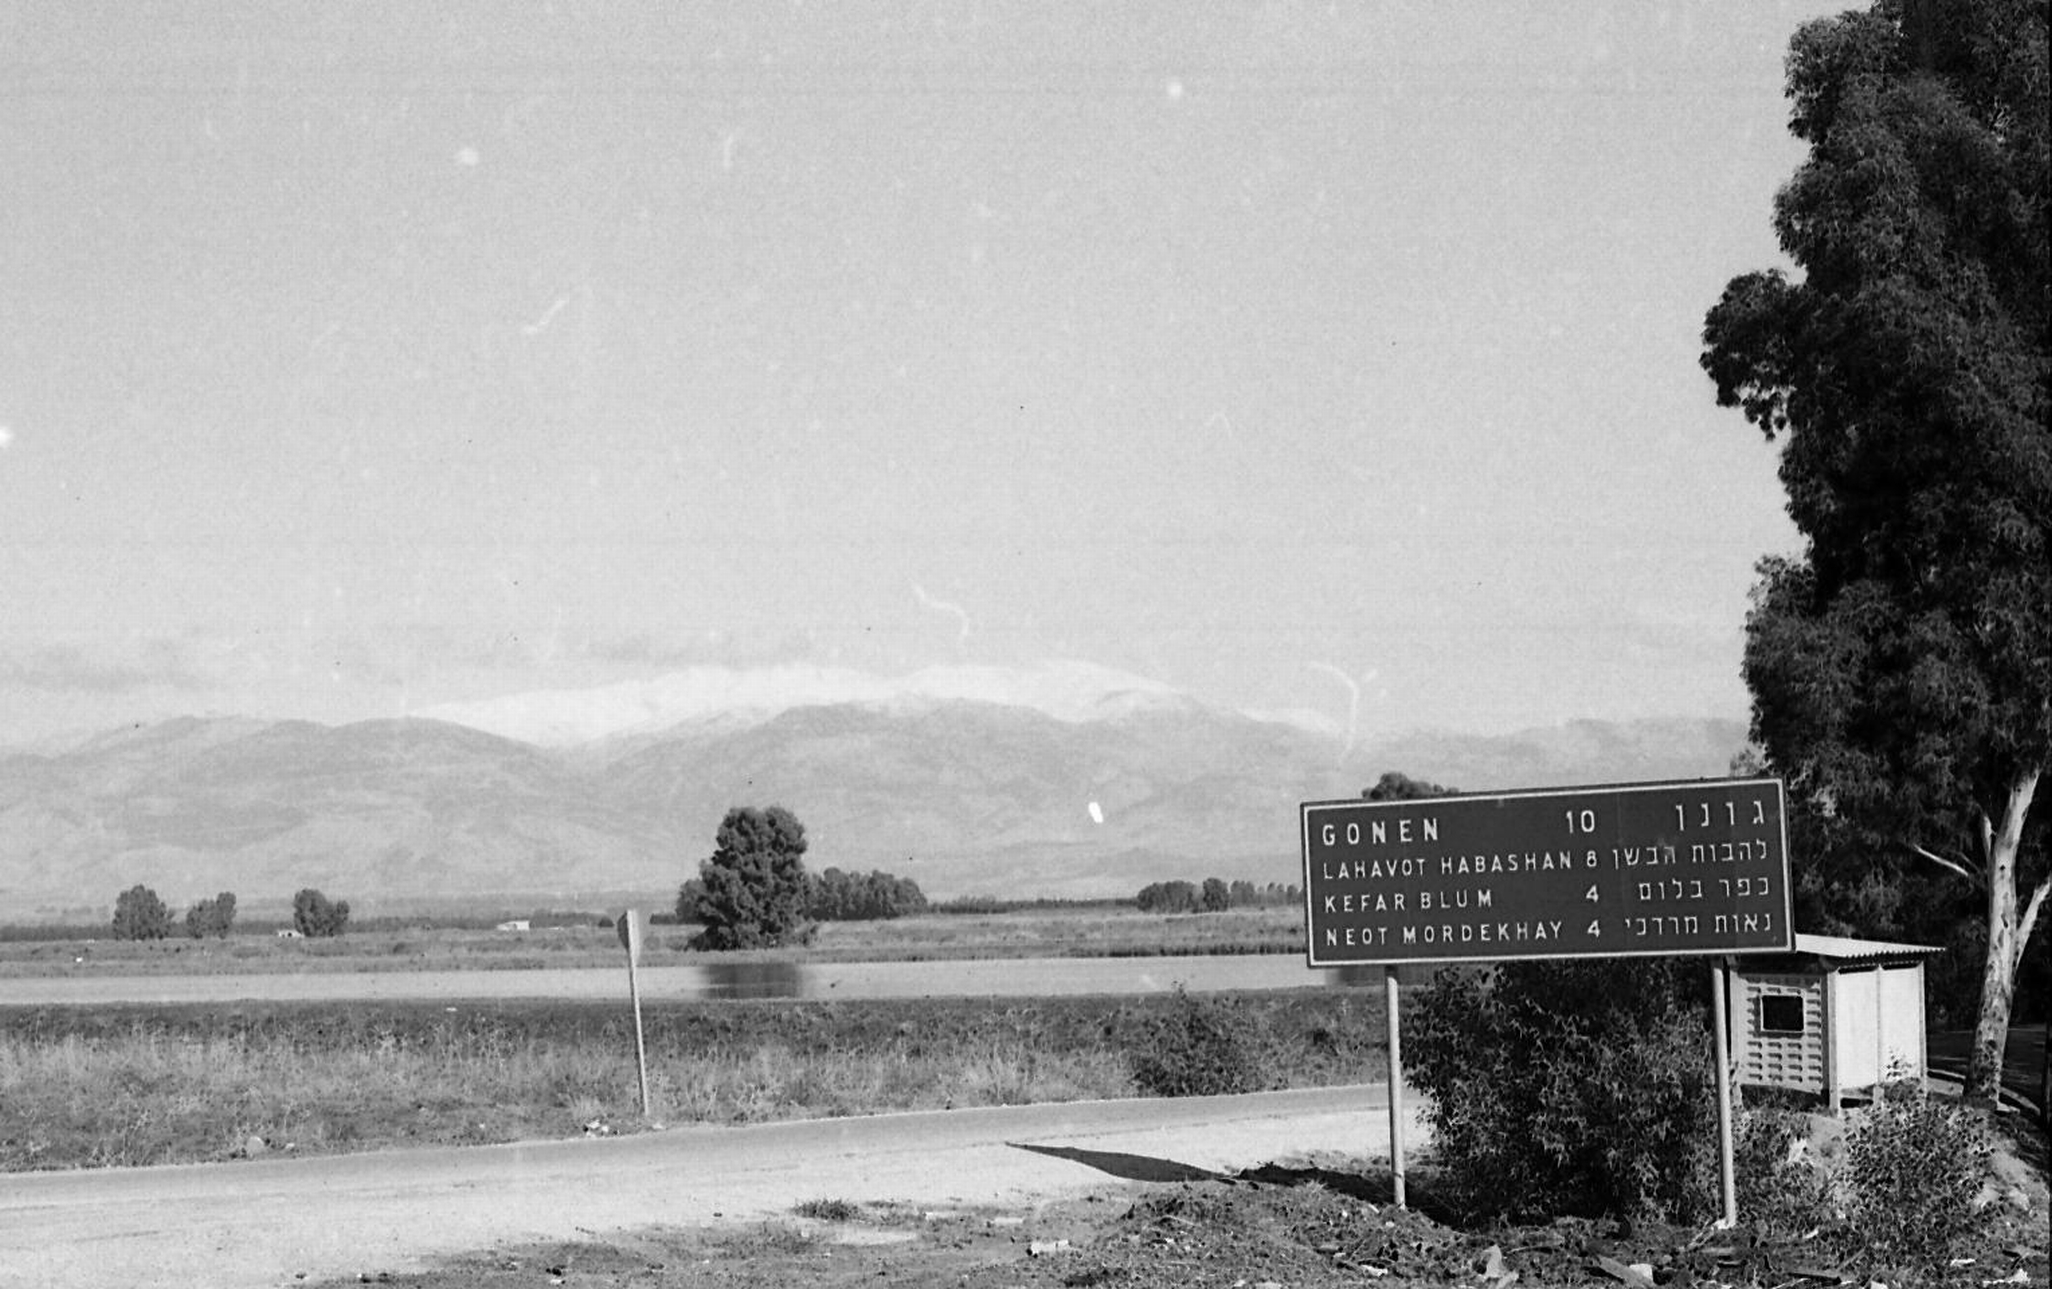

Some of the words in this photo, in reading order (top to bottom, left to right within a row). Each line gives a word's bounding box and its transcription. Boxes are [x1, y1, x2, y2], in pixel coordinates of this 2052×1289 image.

[1322, 817, 1438, 846] GONEN
[1566, 809, 1595, 834] 10
[1675, 799, 1765, 831] גונן
[1612, 845, 1676, 870] הבשן
[1691, 838, 1767, 863] להבות
[1323, 858, 1425, 880] LAHAVOT
[1441, 851, 1571, 875] HABASHAN
[1586, 850, 1597, 868] 8
[1324, 893, 1405, 914] KEFAR
[1420, 889, 1492, 910] BLUM
[1585, 885, 1599, 902] 4
[1638, 878, 1703, 901] בלום
[1718, 877, 1769, 898] כפר
[1326, 927, 1387, 946] NEOT
[1403, 921, 1562, 944] MORDEKHAY
[1587, 919, 1601, 938] 4
[1624, 915, 1698, 936] מרדכי
[1714, 912, 1771, 933] נאות
